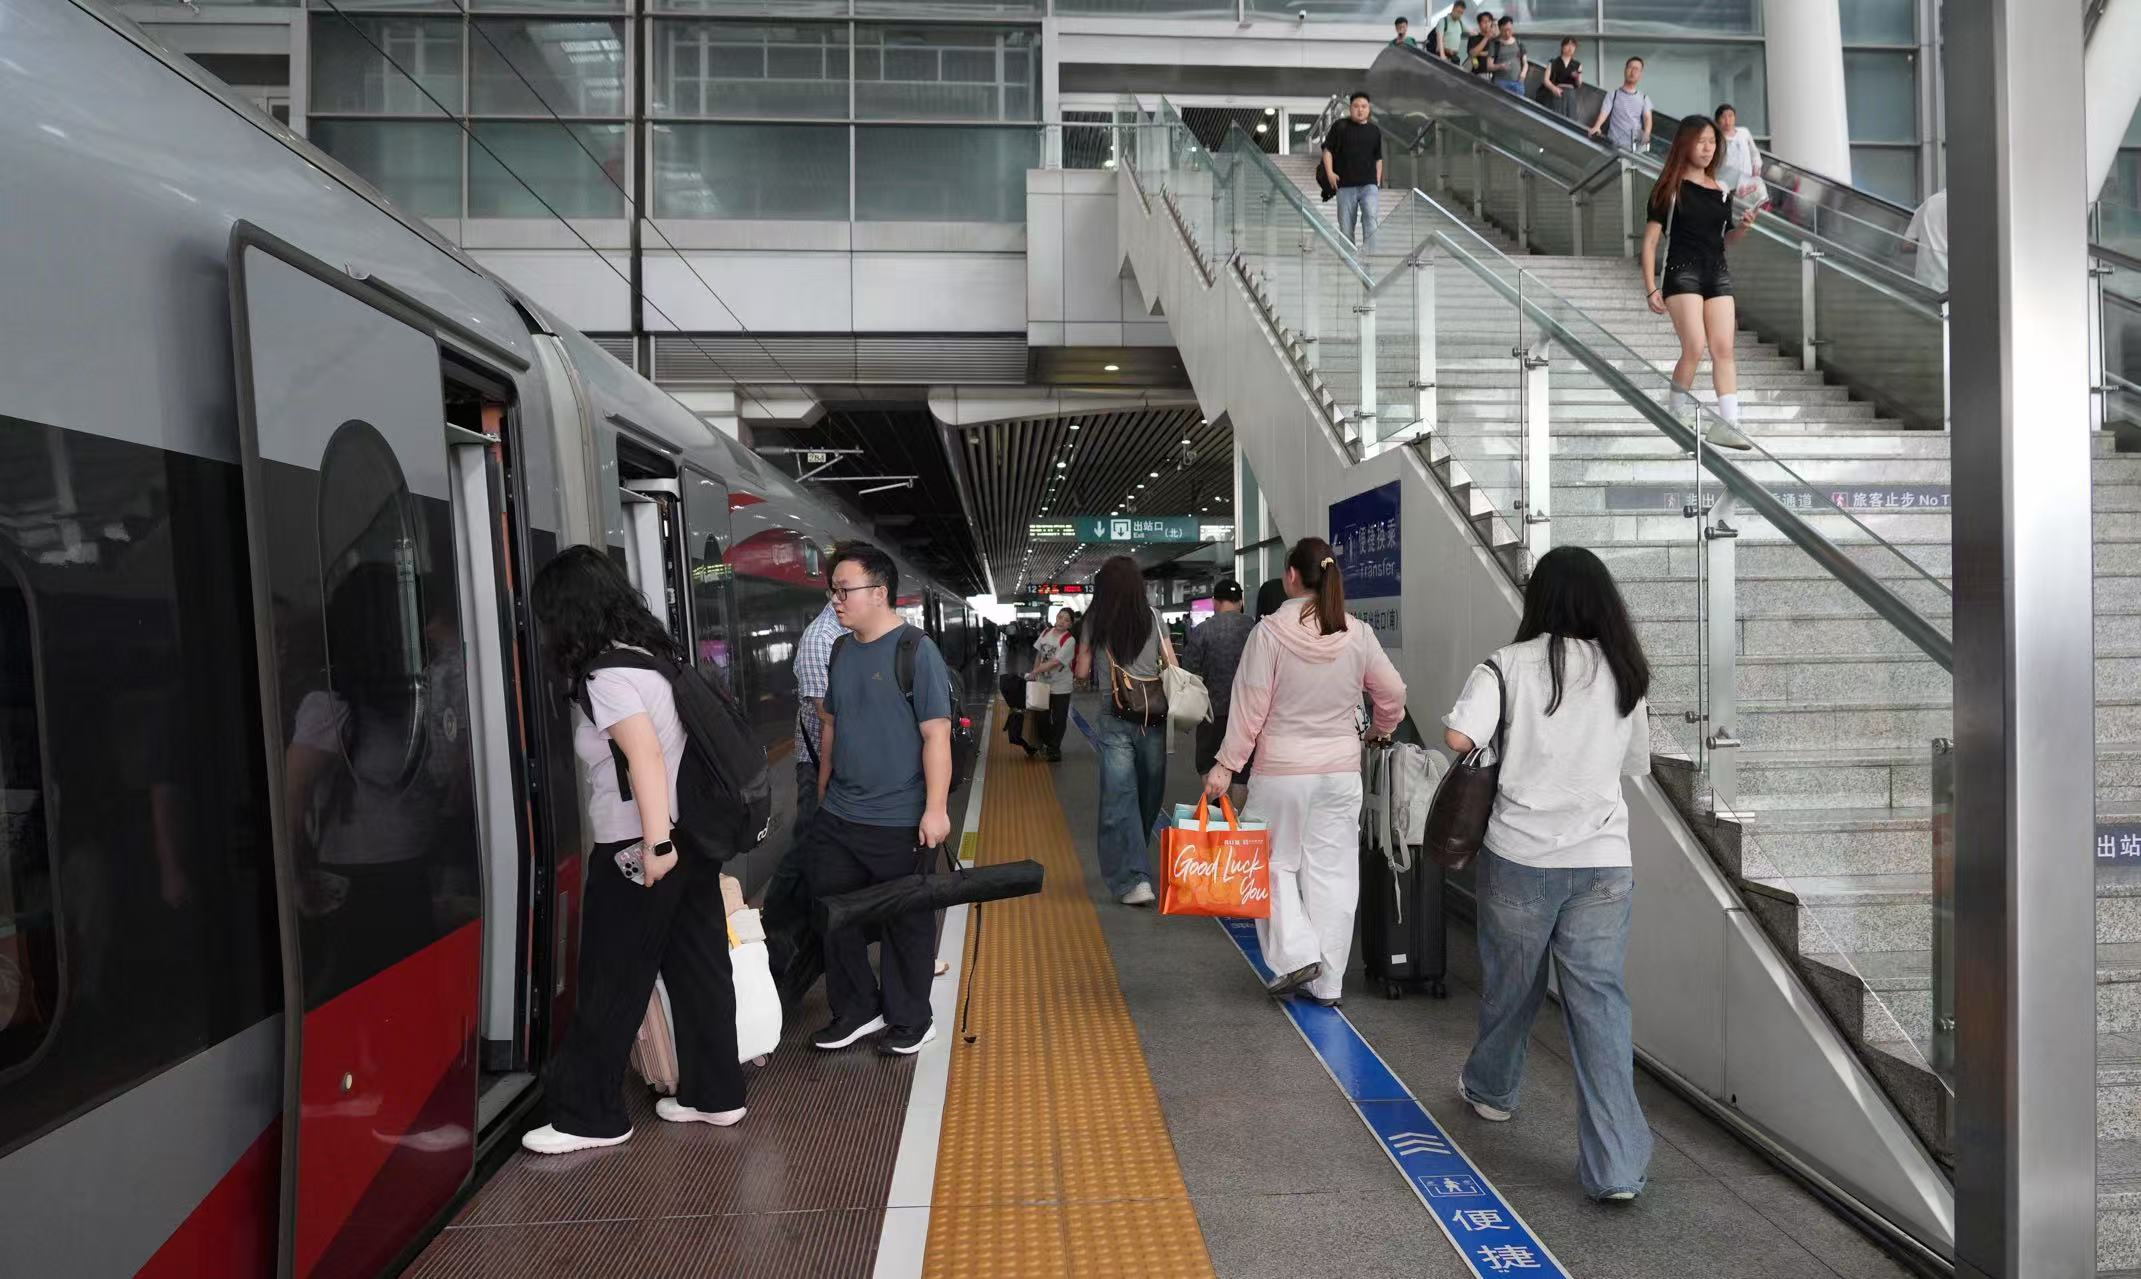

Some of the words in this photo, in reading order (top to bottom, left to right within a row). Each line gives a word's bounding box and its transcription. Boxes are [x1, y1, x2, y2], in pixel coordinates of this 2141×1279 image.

[1853, 491, 1915, 508] 旅客止步
[1919, 494, 1938, 506] No
[1133, 521, 1164, 532] 出站口
[1358, 518, 1397, 555] 便捷换乘
[1359, 558, 1397, 578] Transfer
[2097, 834, 2141, 858] 出站
[1174, 844, 1222, 885] Good
[1222, 845, 1265, 884] Luck
[1240, 876, 1269, 905] You
[1452, 1208, 1541, 1273] 便捷
